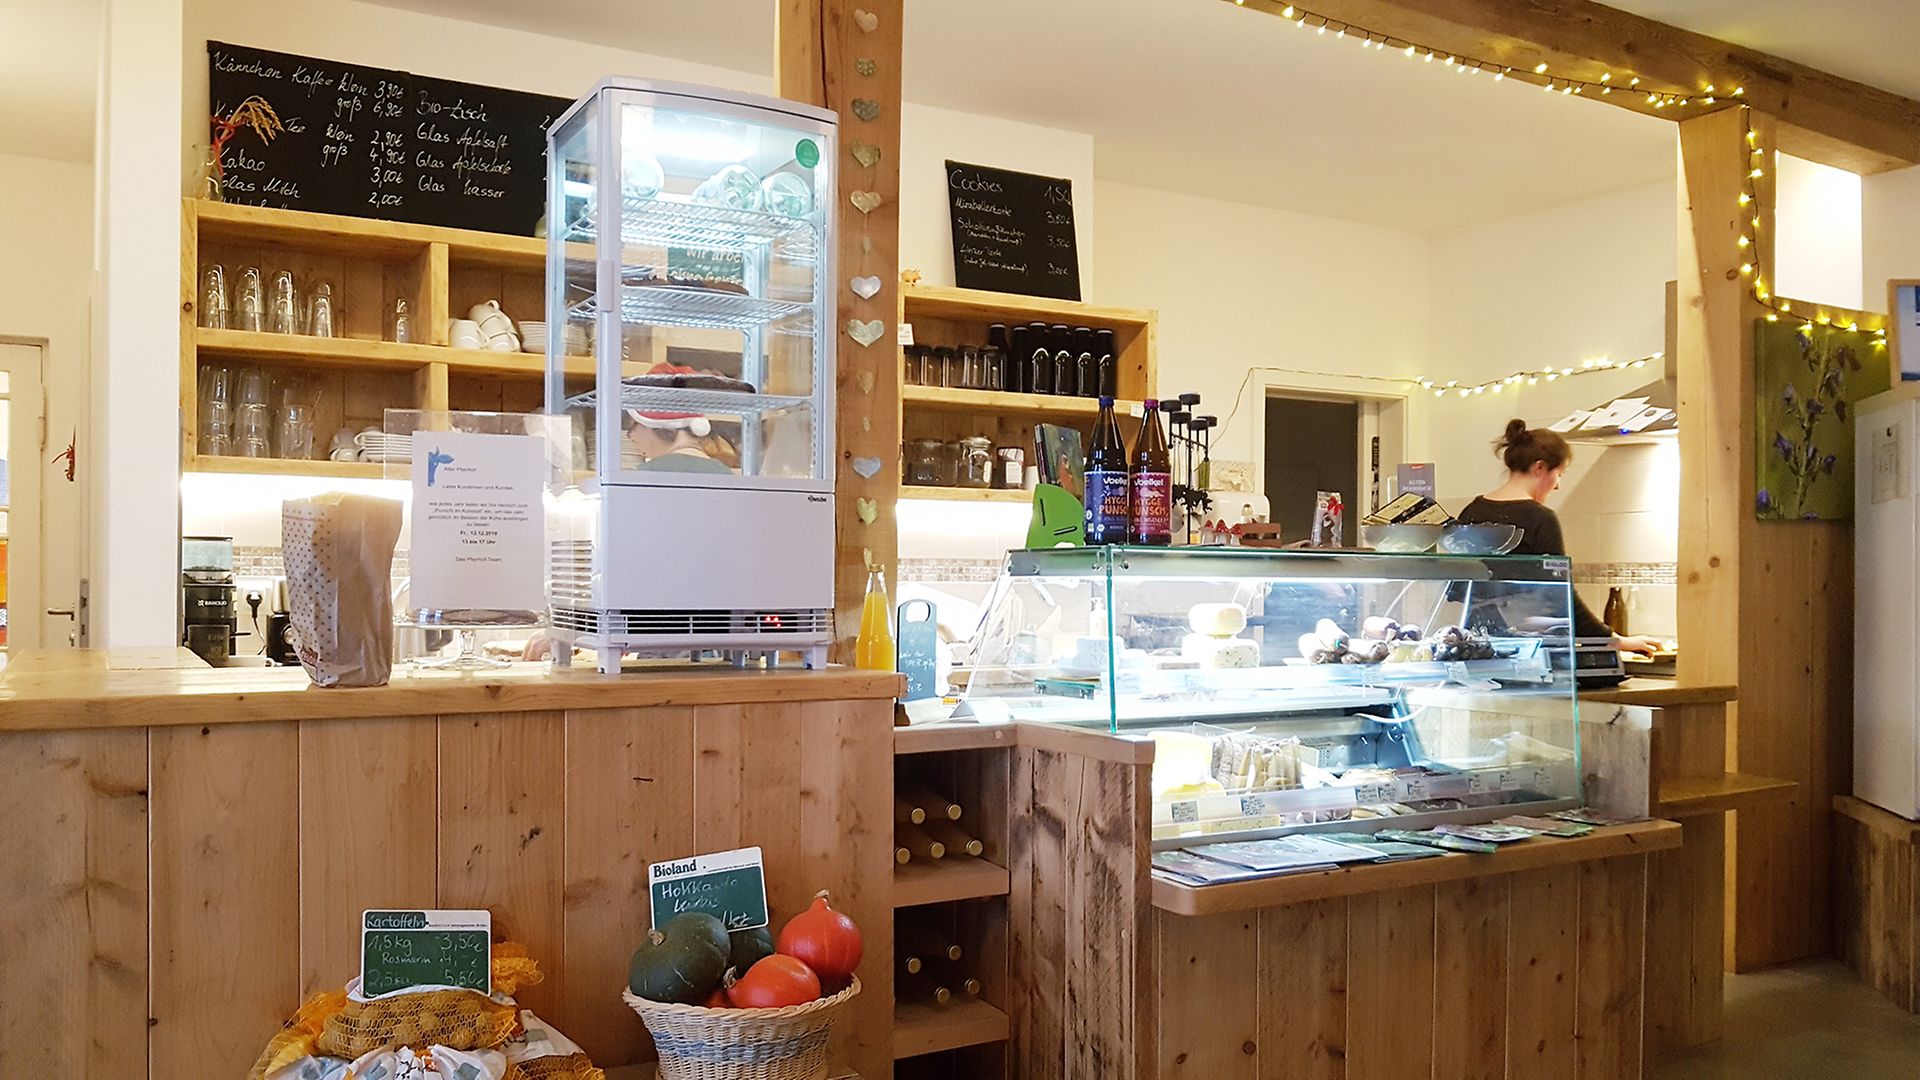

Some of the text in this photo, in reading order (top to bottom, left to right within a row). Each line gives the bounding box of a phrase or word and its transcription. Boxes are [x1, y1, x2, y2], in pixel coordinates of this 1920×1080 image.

[292, 66, 334, 98] Kaffee
[338, 72, 369, 96] klein
[285, 117, 306, 133] Tee
[326, 123, 355, 142] klein
[416, 123, 450, 143] Glas
[416, 151, 445, 168] Glas
[262, 177, 301, 198] Milch
[419, 175, 445, 192] Glas
[950, 169, 1003, 193] Cookies
[1134, 478, 1164, 487] Voelkel
[653, 859, 697, 878] Bioland
[367, 913, 425, 929] Kartoffeln
[382, 952, 431, 965] Rosmarin
